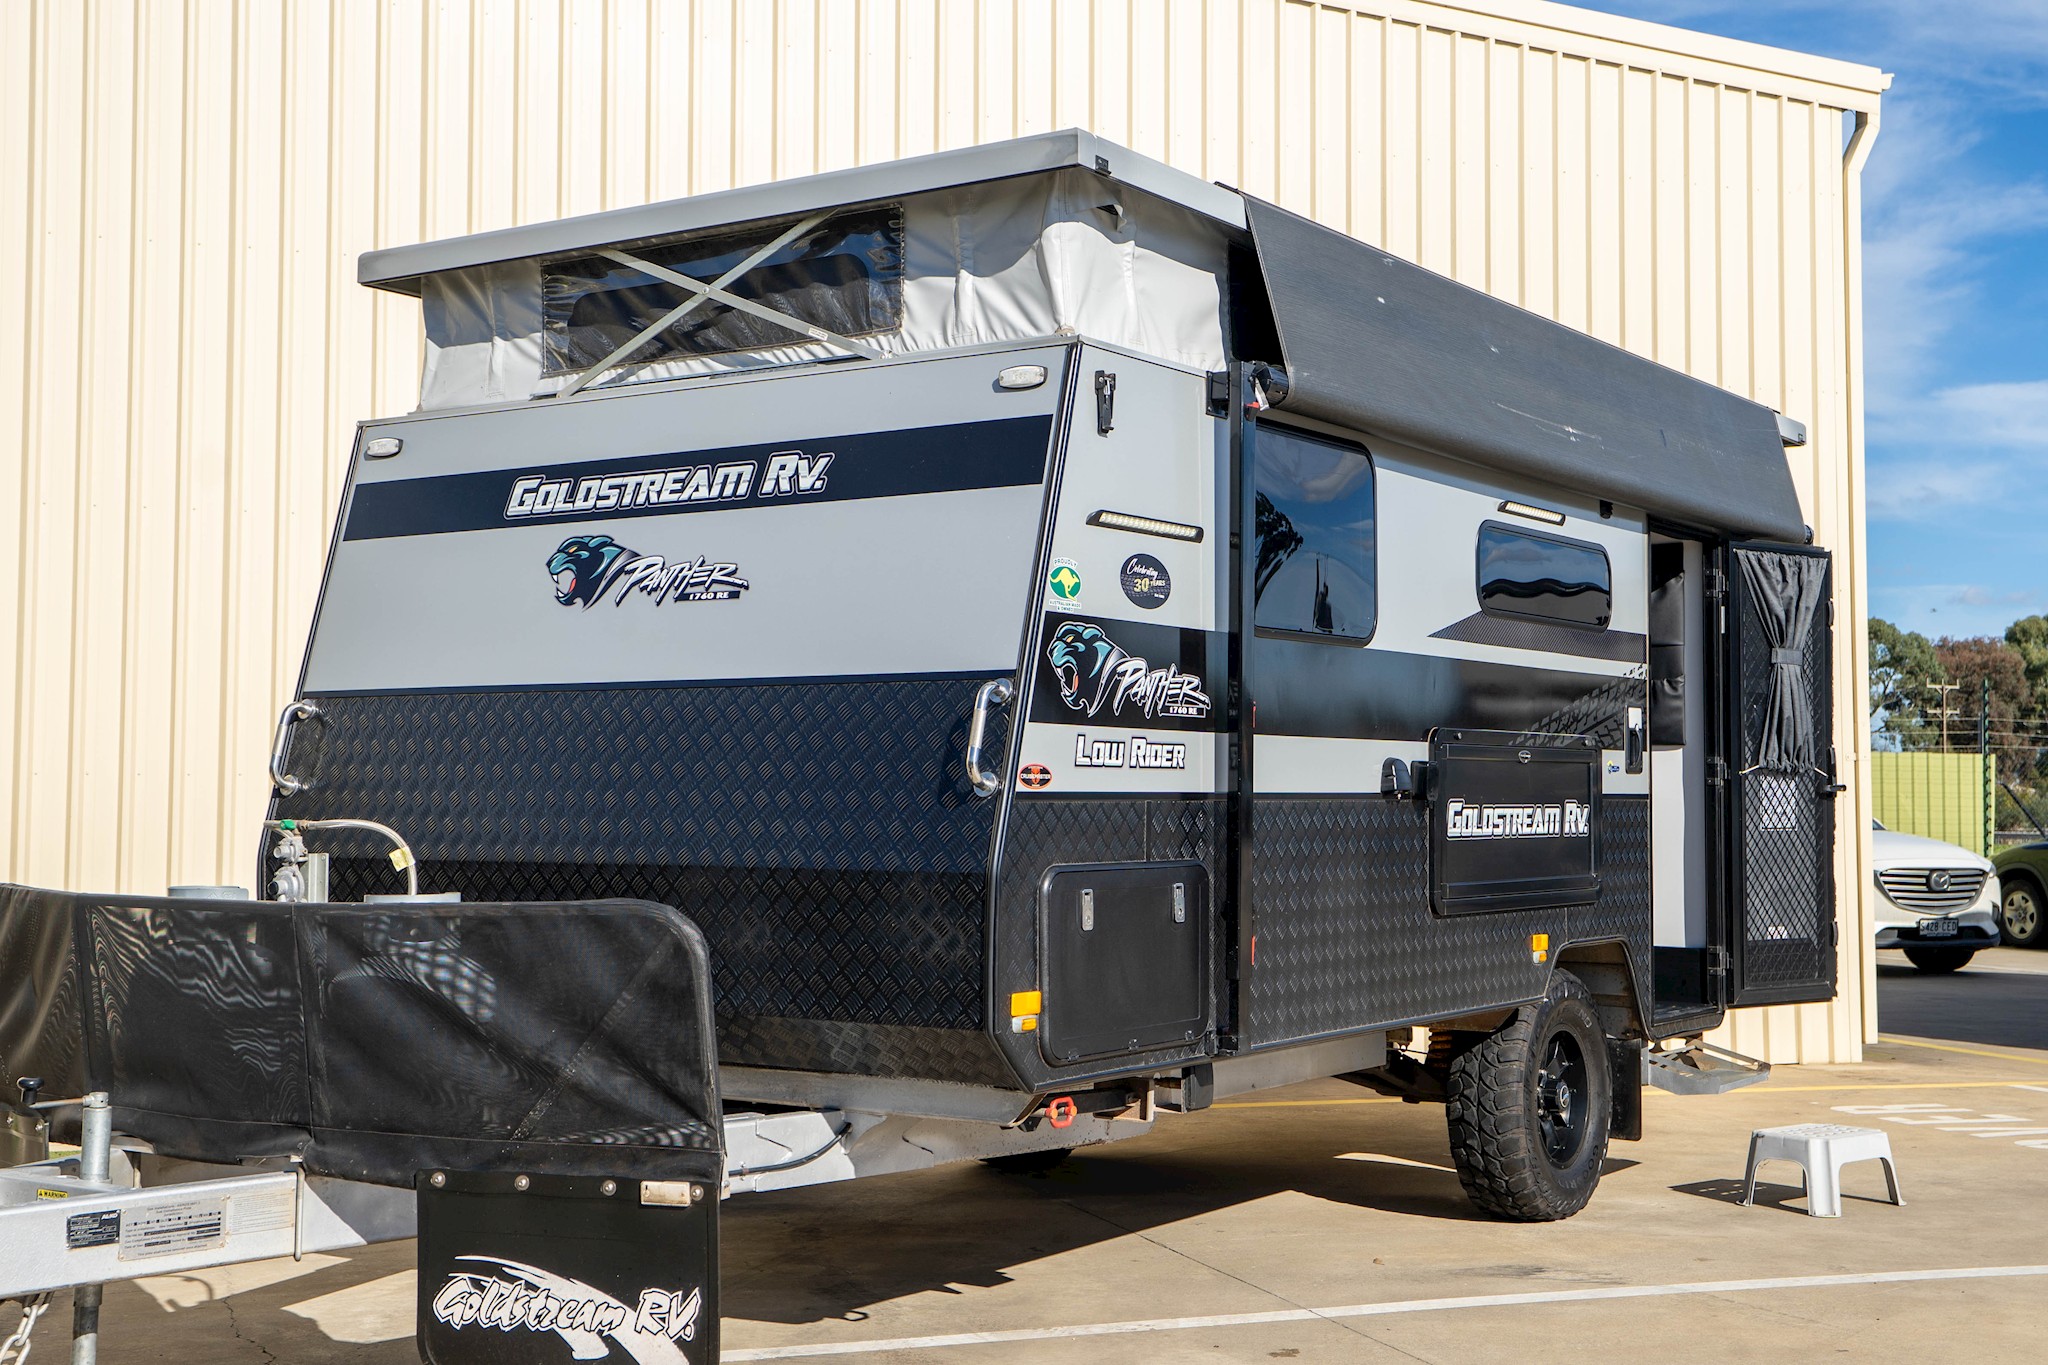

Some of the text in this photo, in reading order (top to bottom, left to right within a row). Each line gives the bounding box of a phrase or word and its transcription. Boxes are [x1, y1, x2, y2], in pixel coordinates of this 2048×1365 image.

[504, 461, 757, 519] GOLDSTREAM
[615, 556, 749, 608] PANTHER
[689, 591, 729, 601] 1760 RE
[1133, 578, 1149, 592] 30
[1113, 657, 1211, 719] PANTHER
[1170, 706, 1197, 715] 1760 RE
[1075, 733, 1186, 769] LOW RIDER
[1447, 798, 1561, 840] GOLDSTREAM
[433, 1275, 627, 1334] Goldstream
